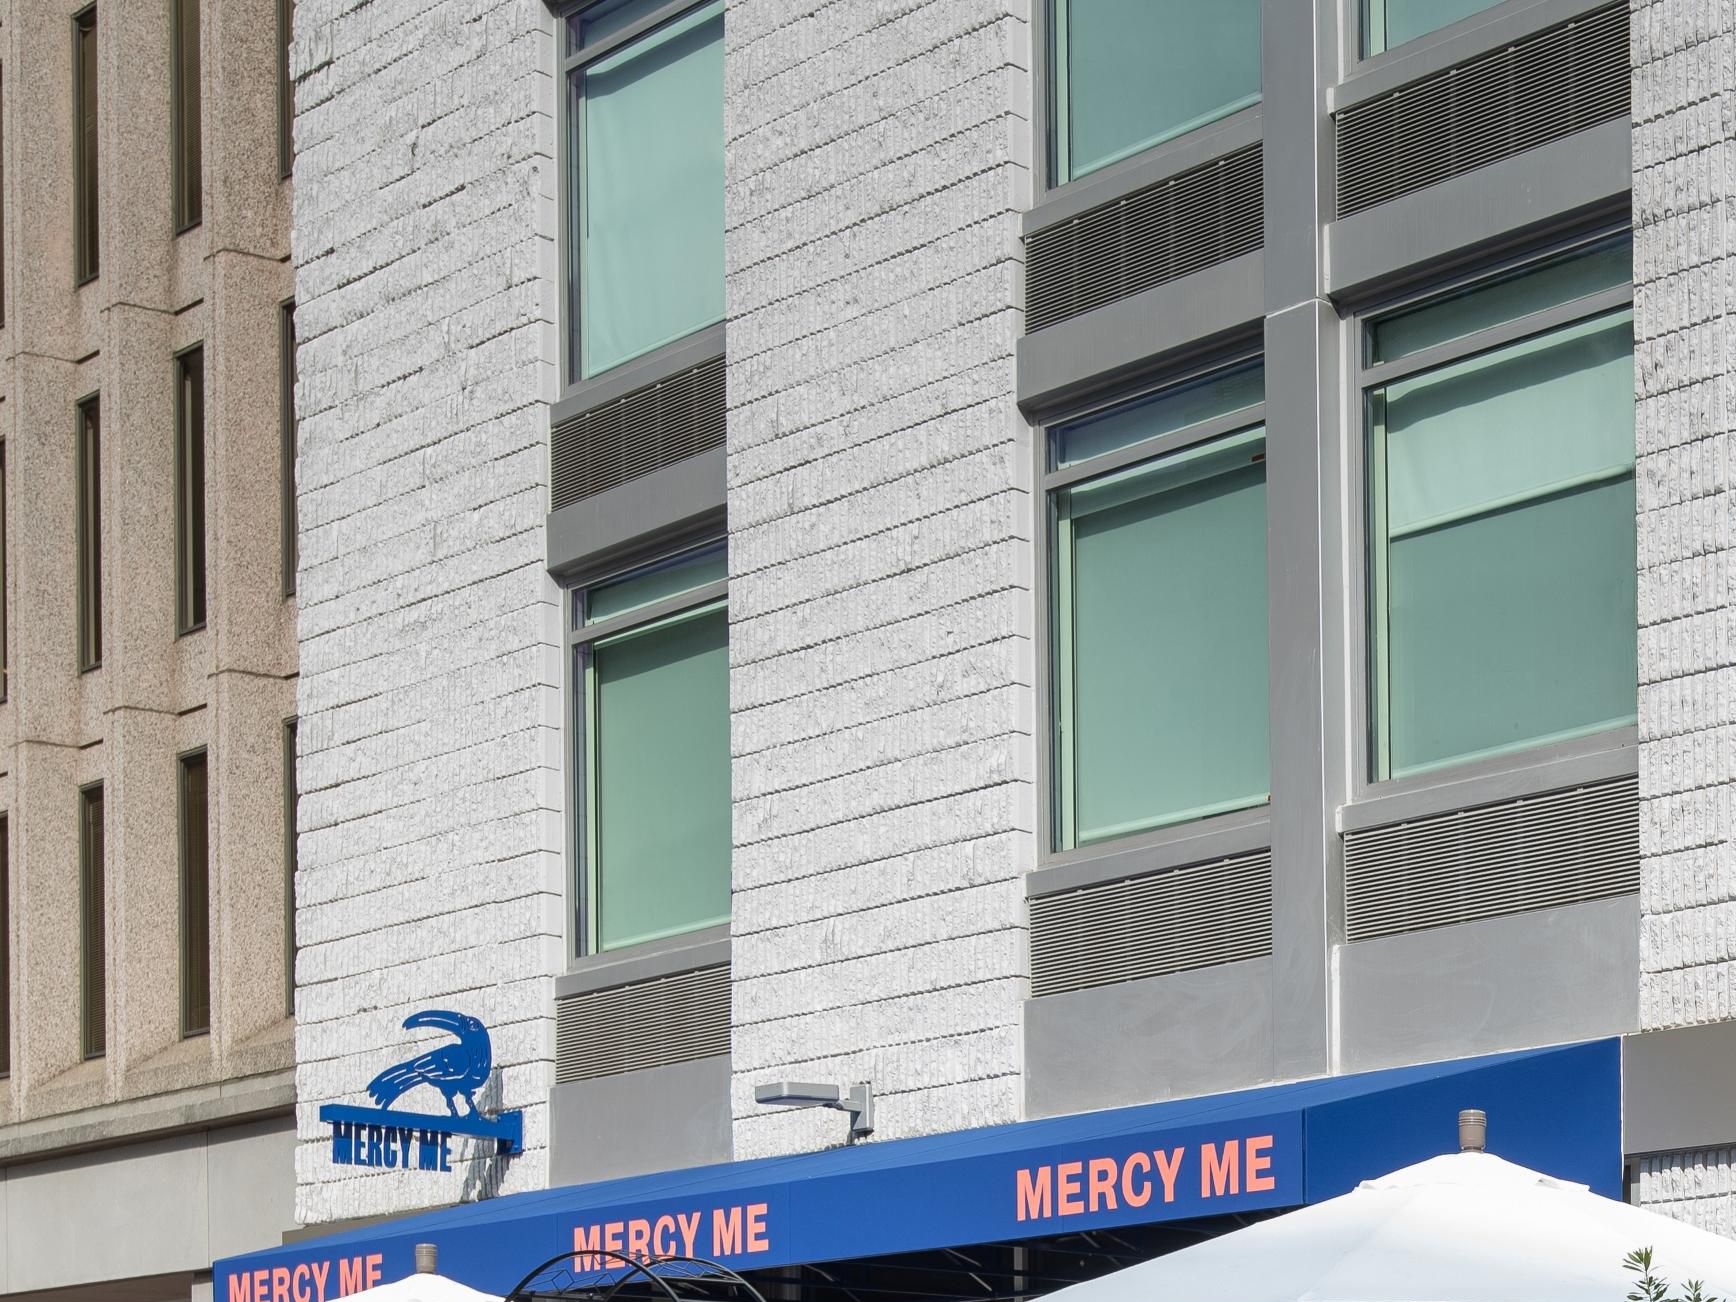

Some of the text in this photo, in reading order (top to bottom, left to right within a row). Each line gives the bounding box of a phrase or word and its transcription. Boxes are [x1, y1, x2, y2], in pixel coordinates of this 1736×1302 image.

[333, 1121, 452, 1172] MERCY ME
[1017, 1135, 1275, 1222] MERCY ME
[574, 1203, 769, 1273] MERCY ME
[339, 1253, 383, 1297] ME
